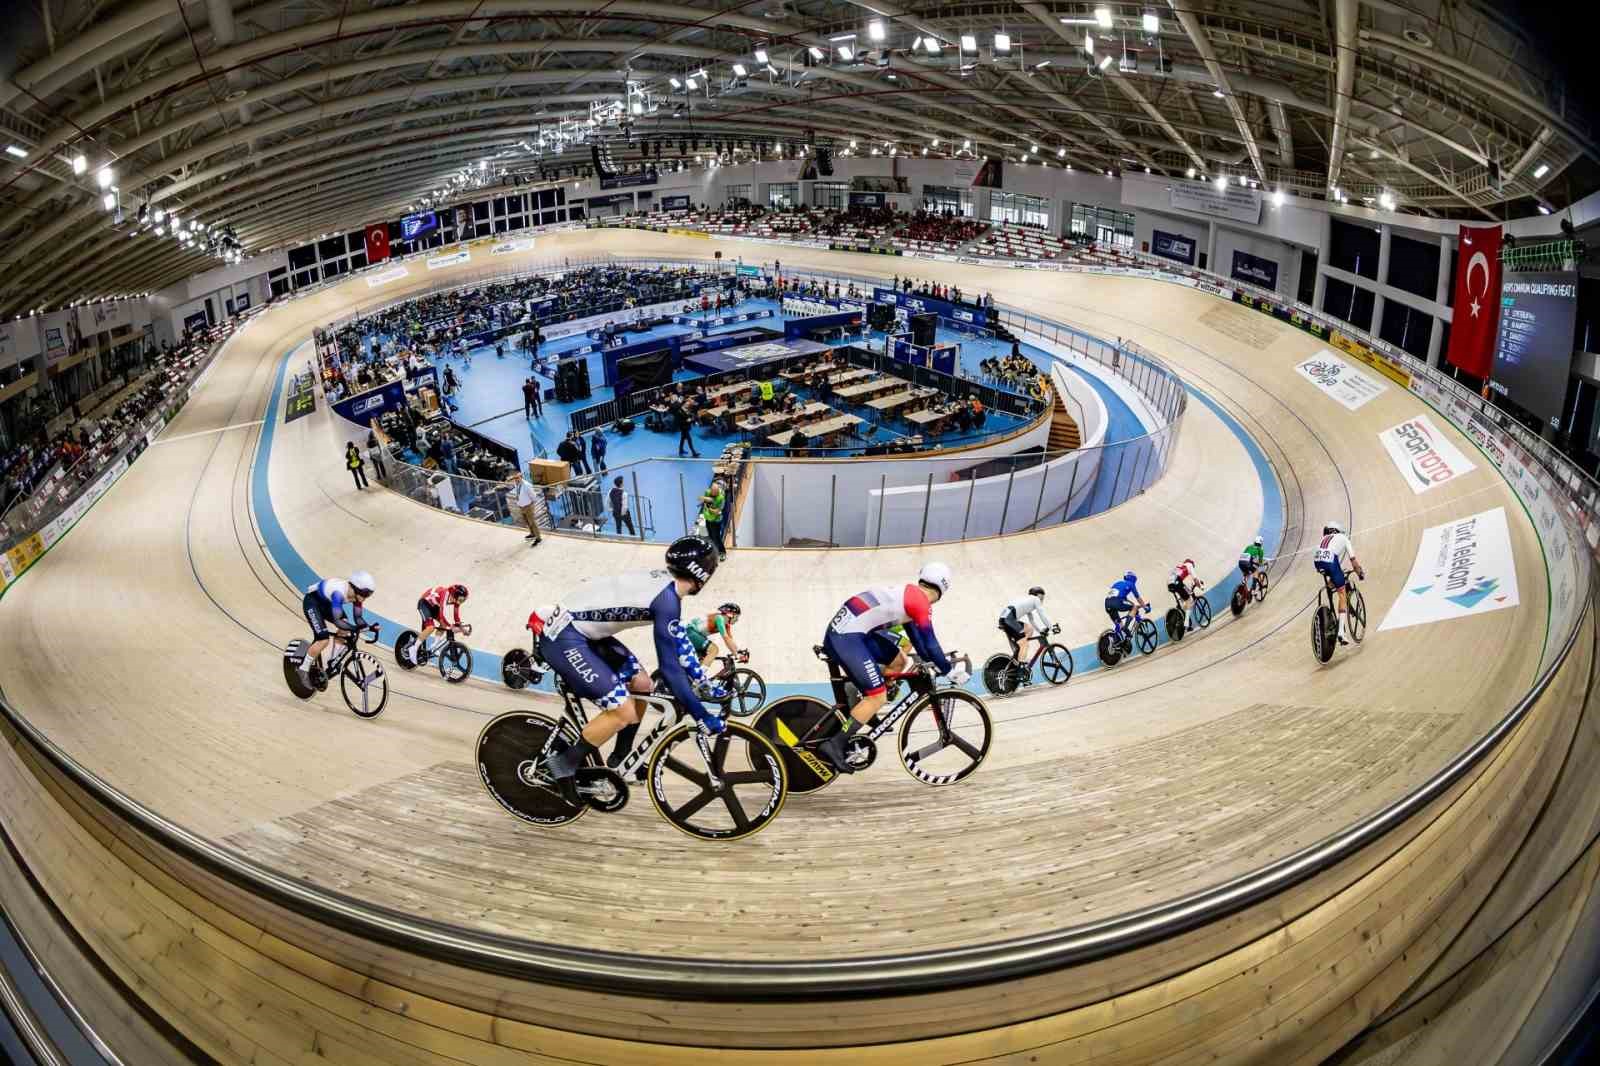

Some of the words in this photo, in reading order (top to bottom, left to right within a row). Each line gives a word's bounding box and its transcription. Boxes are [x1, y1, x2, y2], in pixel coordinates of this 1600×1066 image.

[1455, 518, 1477, 542] Türk
[1446, 542, 1476, 591] Telekom
[563, 647, 599, 684] HELLAS
[869, 702, 907, 739] ARGON
[906, 691, 919, 705] 18
[622, 719, 668, 773] OOK
